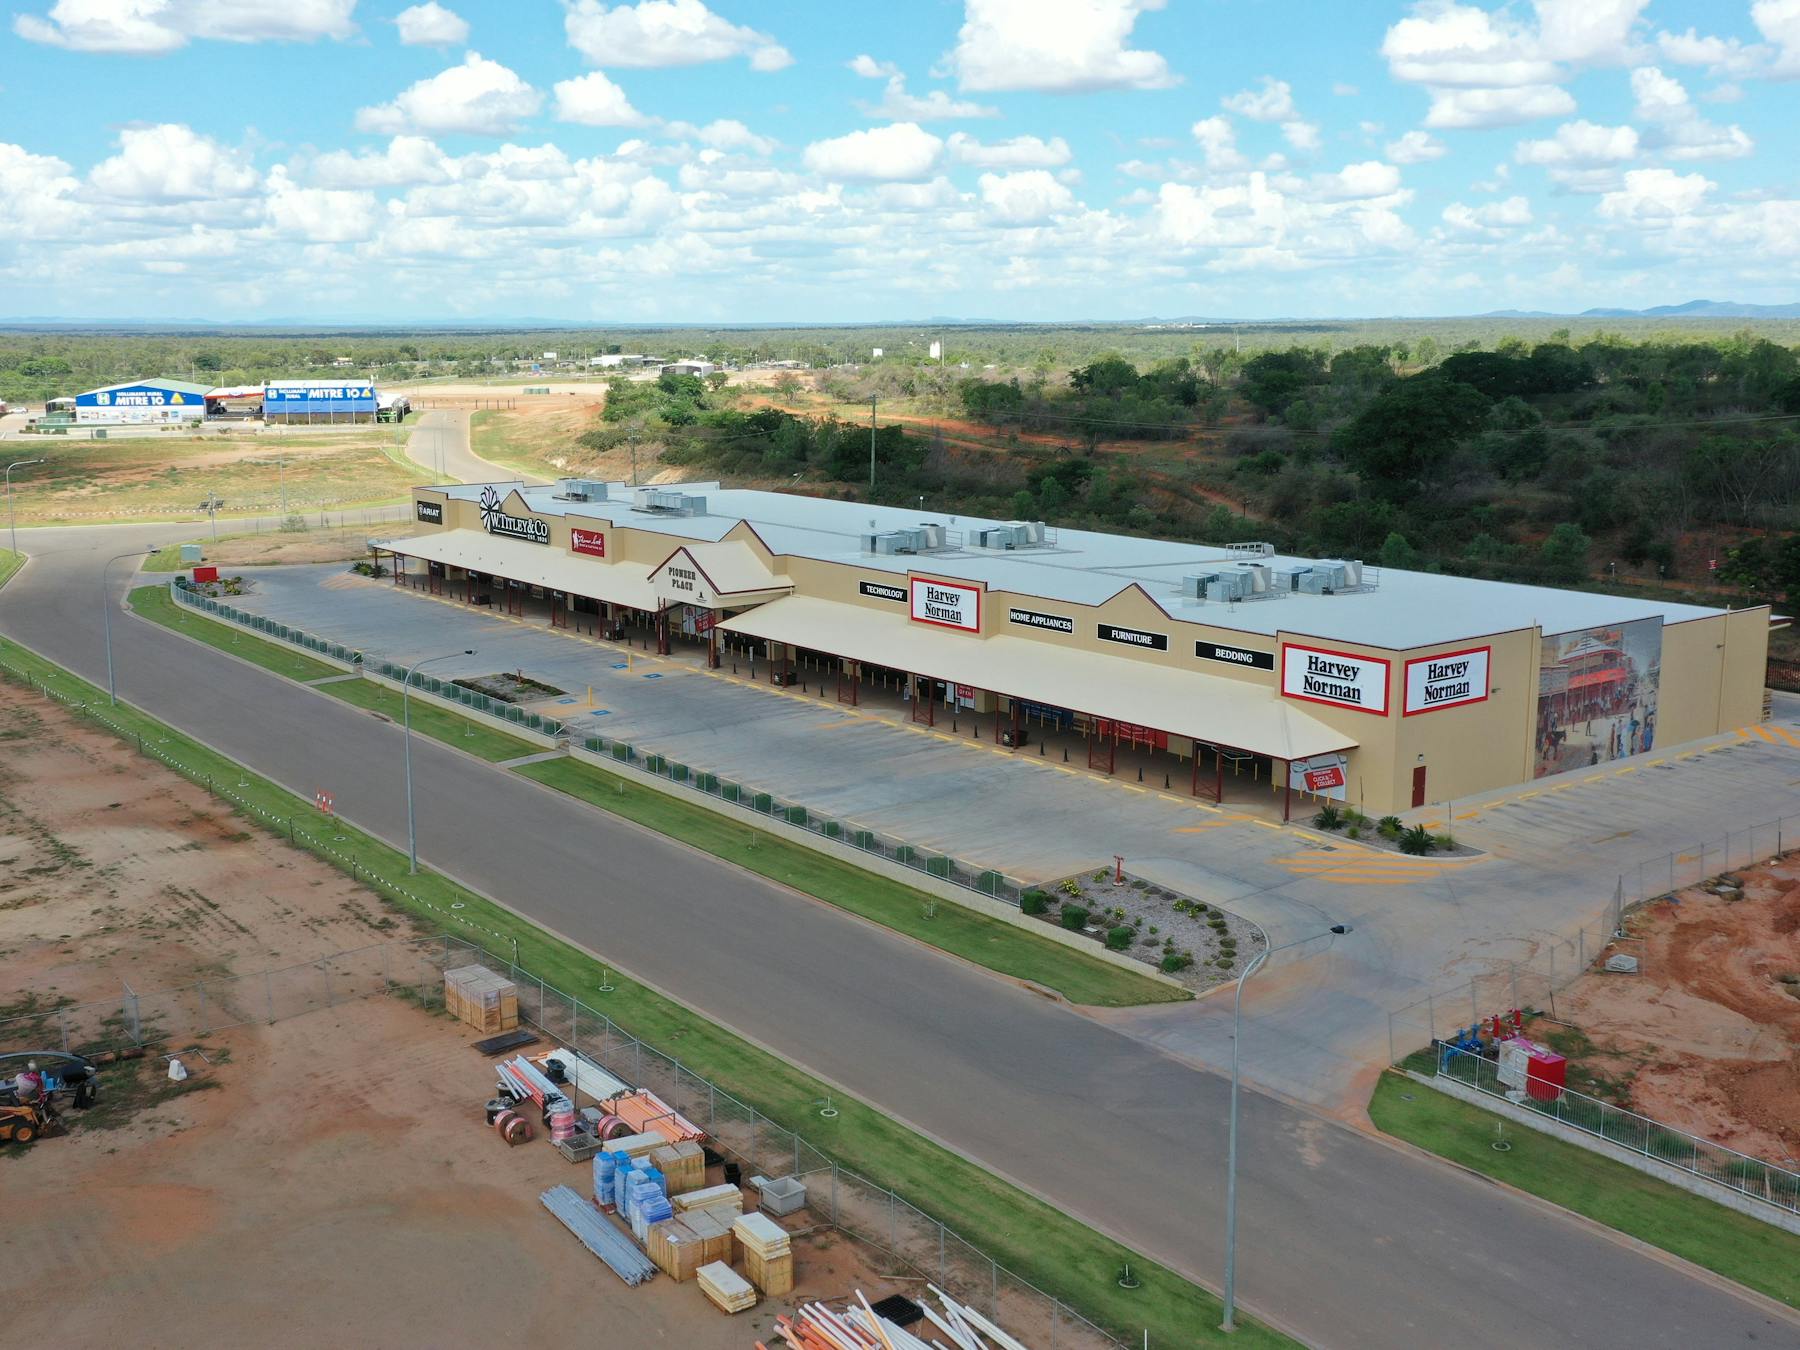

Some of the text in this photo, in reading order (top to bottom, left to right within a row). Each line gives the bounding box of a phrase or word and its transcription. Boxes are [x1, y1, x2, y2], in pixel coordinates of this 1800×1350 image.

[115, 396, 164, 405] MITRE 10
[309, 388, 360, 399] MITRE 10
[422, 507, 440, 517] ARIAT
[668, 567, 696, 580] PIONEER
[672, 579, 693, 591] PLACE
[866, 585, 904, 599] TECHNOLOGY
[926, 586, 960, 606] Harvey
[925, 603, 962, 621] Norman
[1010, 611, 1072, 631] HOME APPLIANCES
[1111, 629, 1153, 645] FURNITURE
[1215, 648, 1253, 663] BEDDING
[1307, 655, 1360, 681] Harvey
[1427, 660, 1469, 680] Harvey
[1303, 675, 1361, 700] Norman
[1424, 681, 1470, 702] Norman
